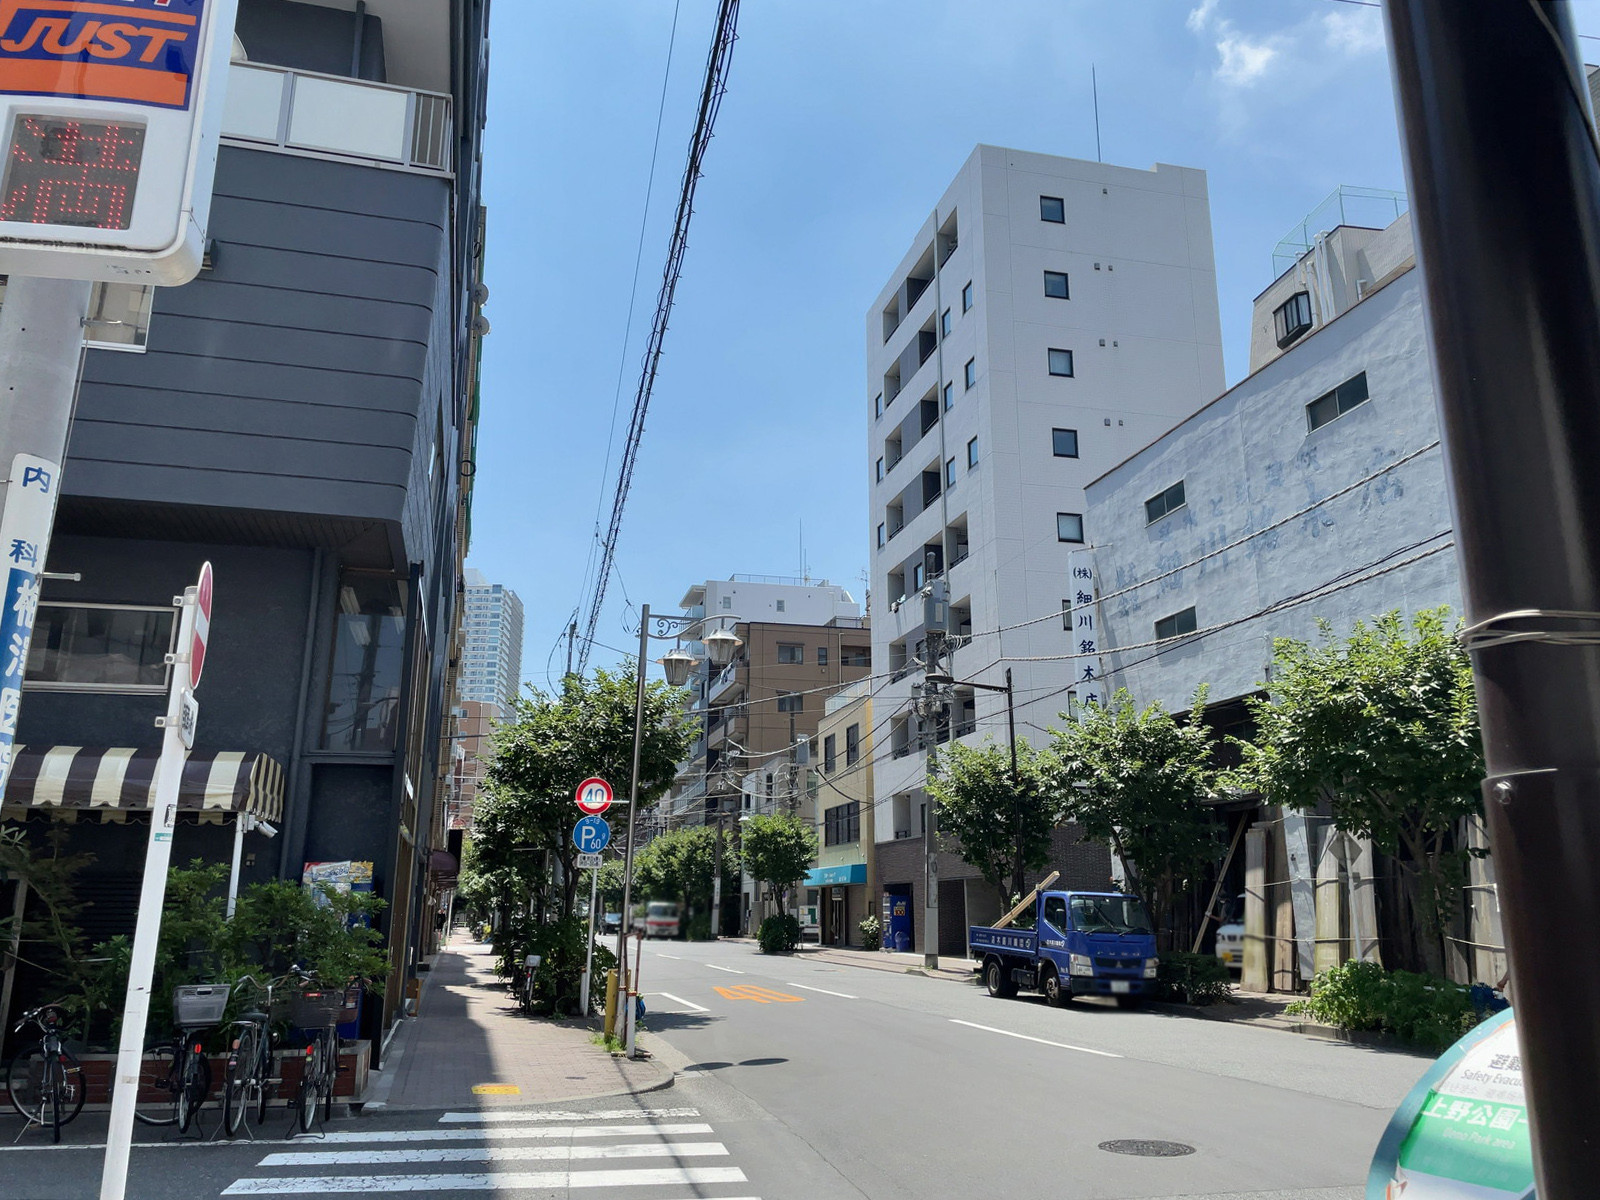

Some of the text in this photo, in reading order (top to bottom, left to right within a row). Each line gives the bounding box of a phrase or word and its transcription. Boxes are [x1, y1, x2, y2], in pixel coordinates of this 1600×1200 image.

[1, 17, 188, 63] JUST
[8, 466, 51, 569] 内科
[585, 788, 604, 803] 40
[581, 825, 596, 849] P
[711, 984, 808, 1004] 40
[1460, 1069, 1523, 1087] Safety Evacu
[1469, 1131, 1492, 1146] Park
